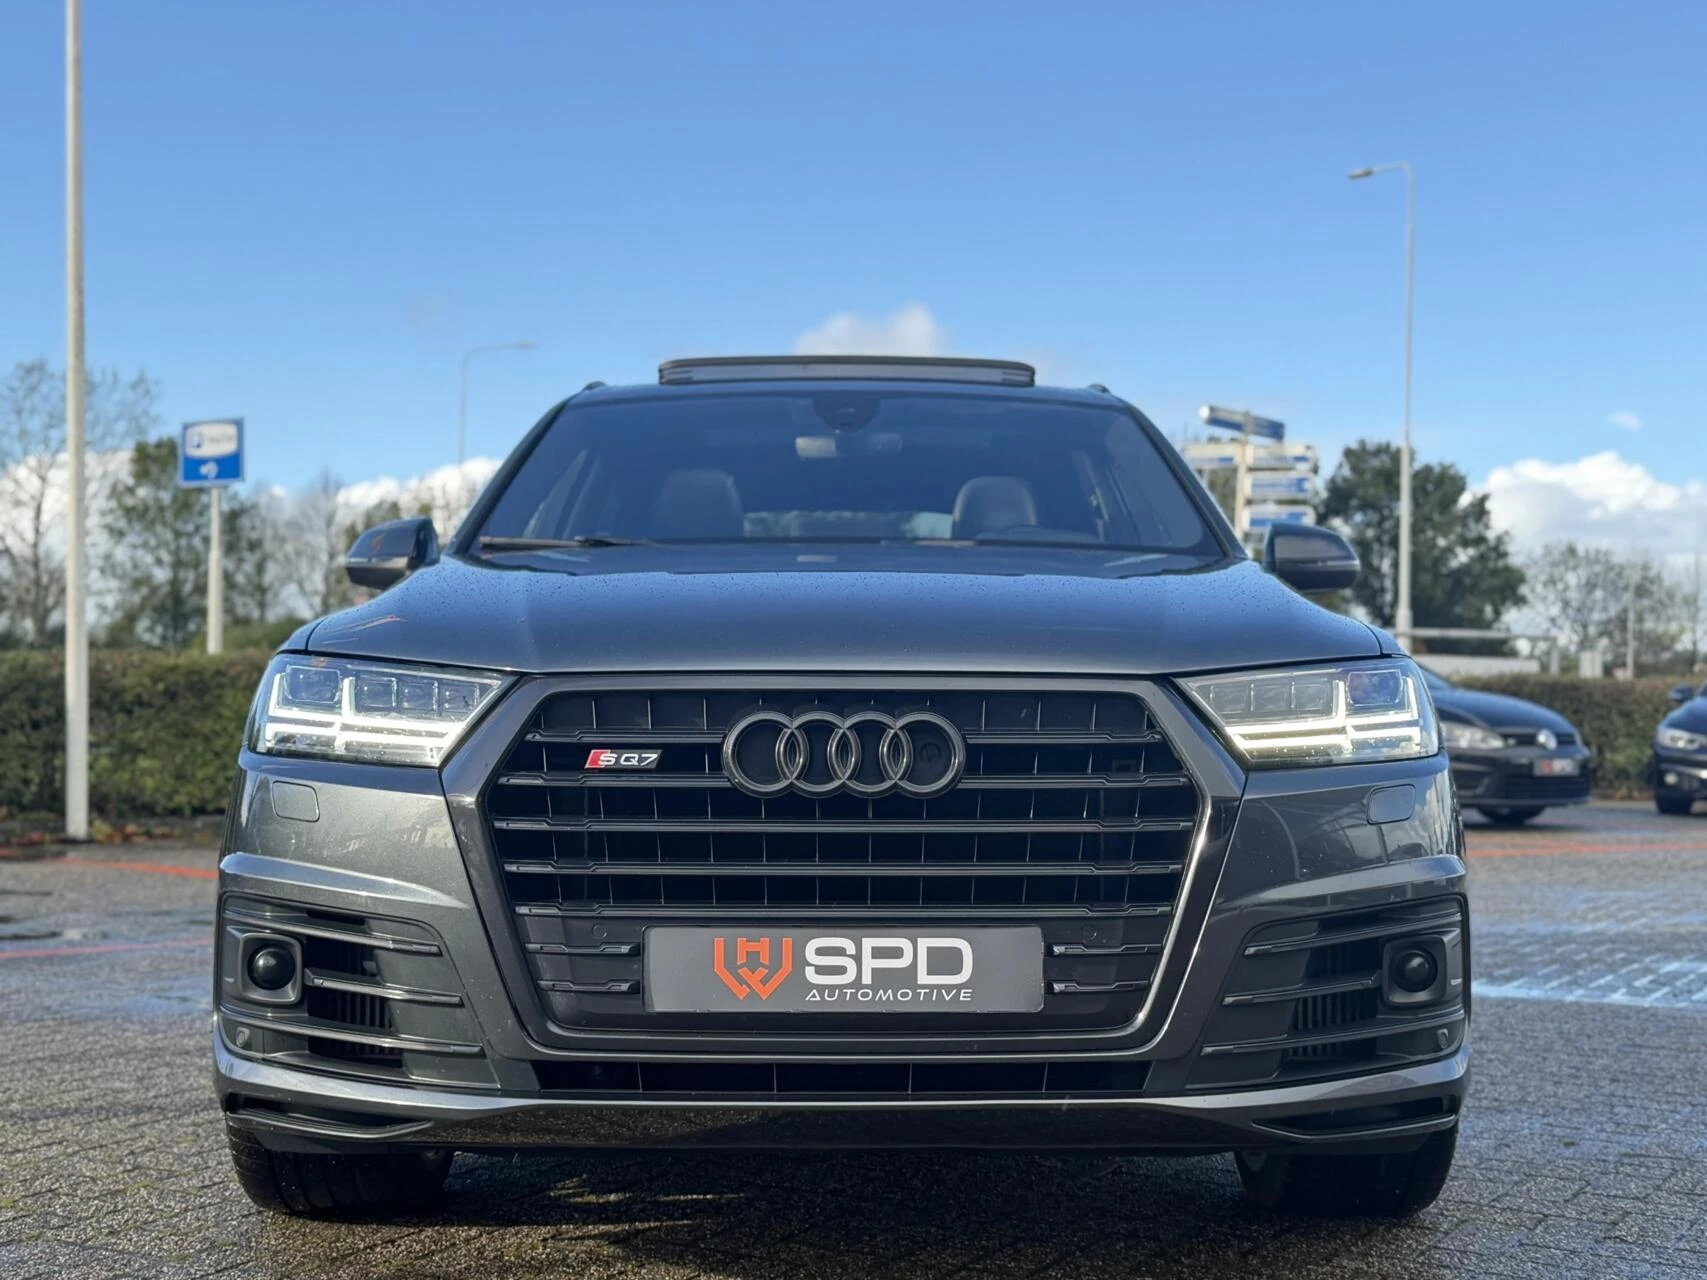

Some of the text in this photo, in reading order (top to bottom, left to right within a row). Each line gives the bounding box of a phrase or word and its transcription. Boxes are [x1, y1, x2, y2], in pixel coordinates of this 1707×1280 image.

[598, 752, 659, 766] SQ7
[804, 937, 974, 985] SPD
[805, 988, 974, 1001] AUTOMOTIVE
